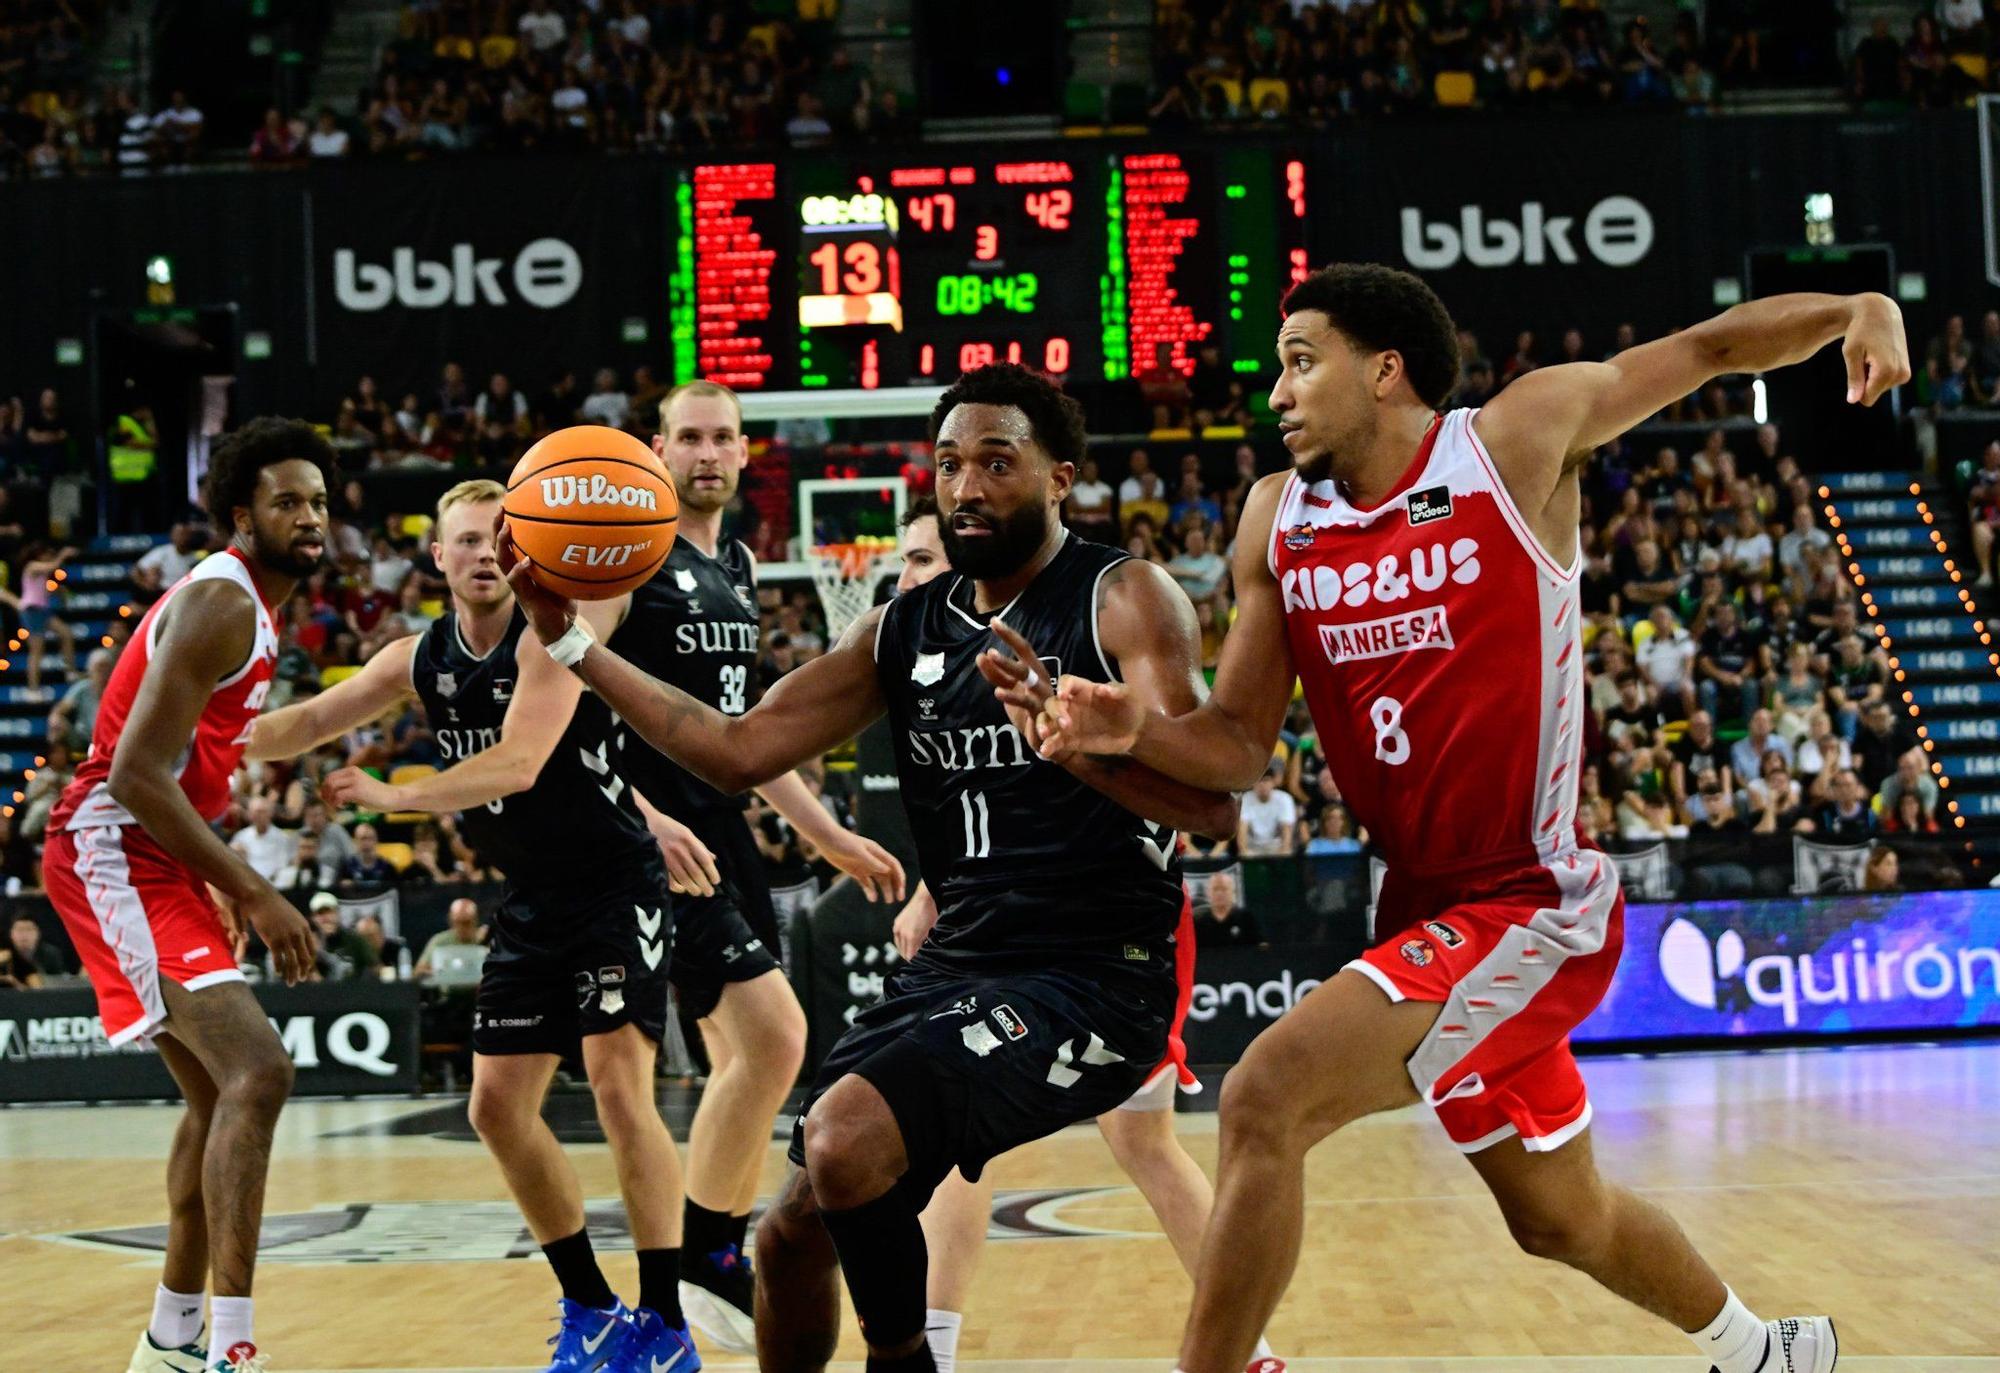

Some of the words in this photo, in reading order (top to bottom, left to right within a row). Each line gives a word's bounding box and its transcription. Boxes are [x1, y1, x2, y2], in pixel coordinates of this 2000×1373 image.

[908, 193, 955, 232] 47
[1025, 189, 1072, 229] 42
[975, 225, 997, 260] 3
[1401, 202, 1578, 270] bbk
[334, 243, 508, 312] bbk
[810, 241, 882, 295] 13
[937, 273, 1038, 315] 08:42
[1045, 338, 1070, 373] 0
[540, 474, 657, 511] Wilson
[1411, 501, 1428, 512] liga
[1412, 505, 1449, 521] endesa
[1281, 538, 1481, 614] KIDS&US
[719, 664, 747, 714] 32
[1933, 685, 1980, 704] IMQ
[908, 723, 1031, 771] surn
[1370, 696, 1411, 765] 8
[1948, 720, 1997, 739] IMQ
[960, 789, 990, 857] 11
[848, 971, 885, 996] bb
[1745, 937, 2000, 1027] quirón
[996, 1011, 1015, 1032] acb
[268, 1012, 398, 1076] MQ
